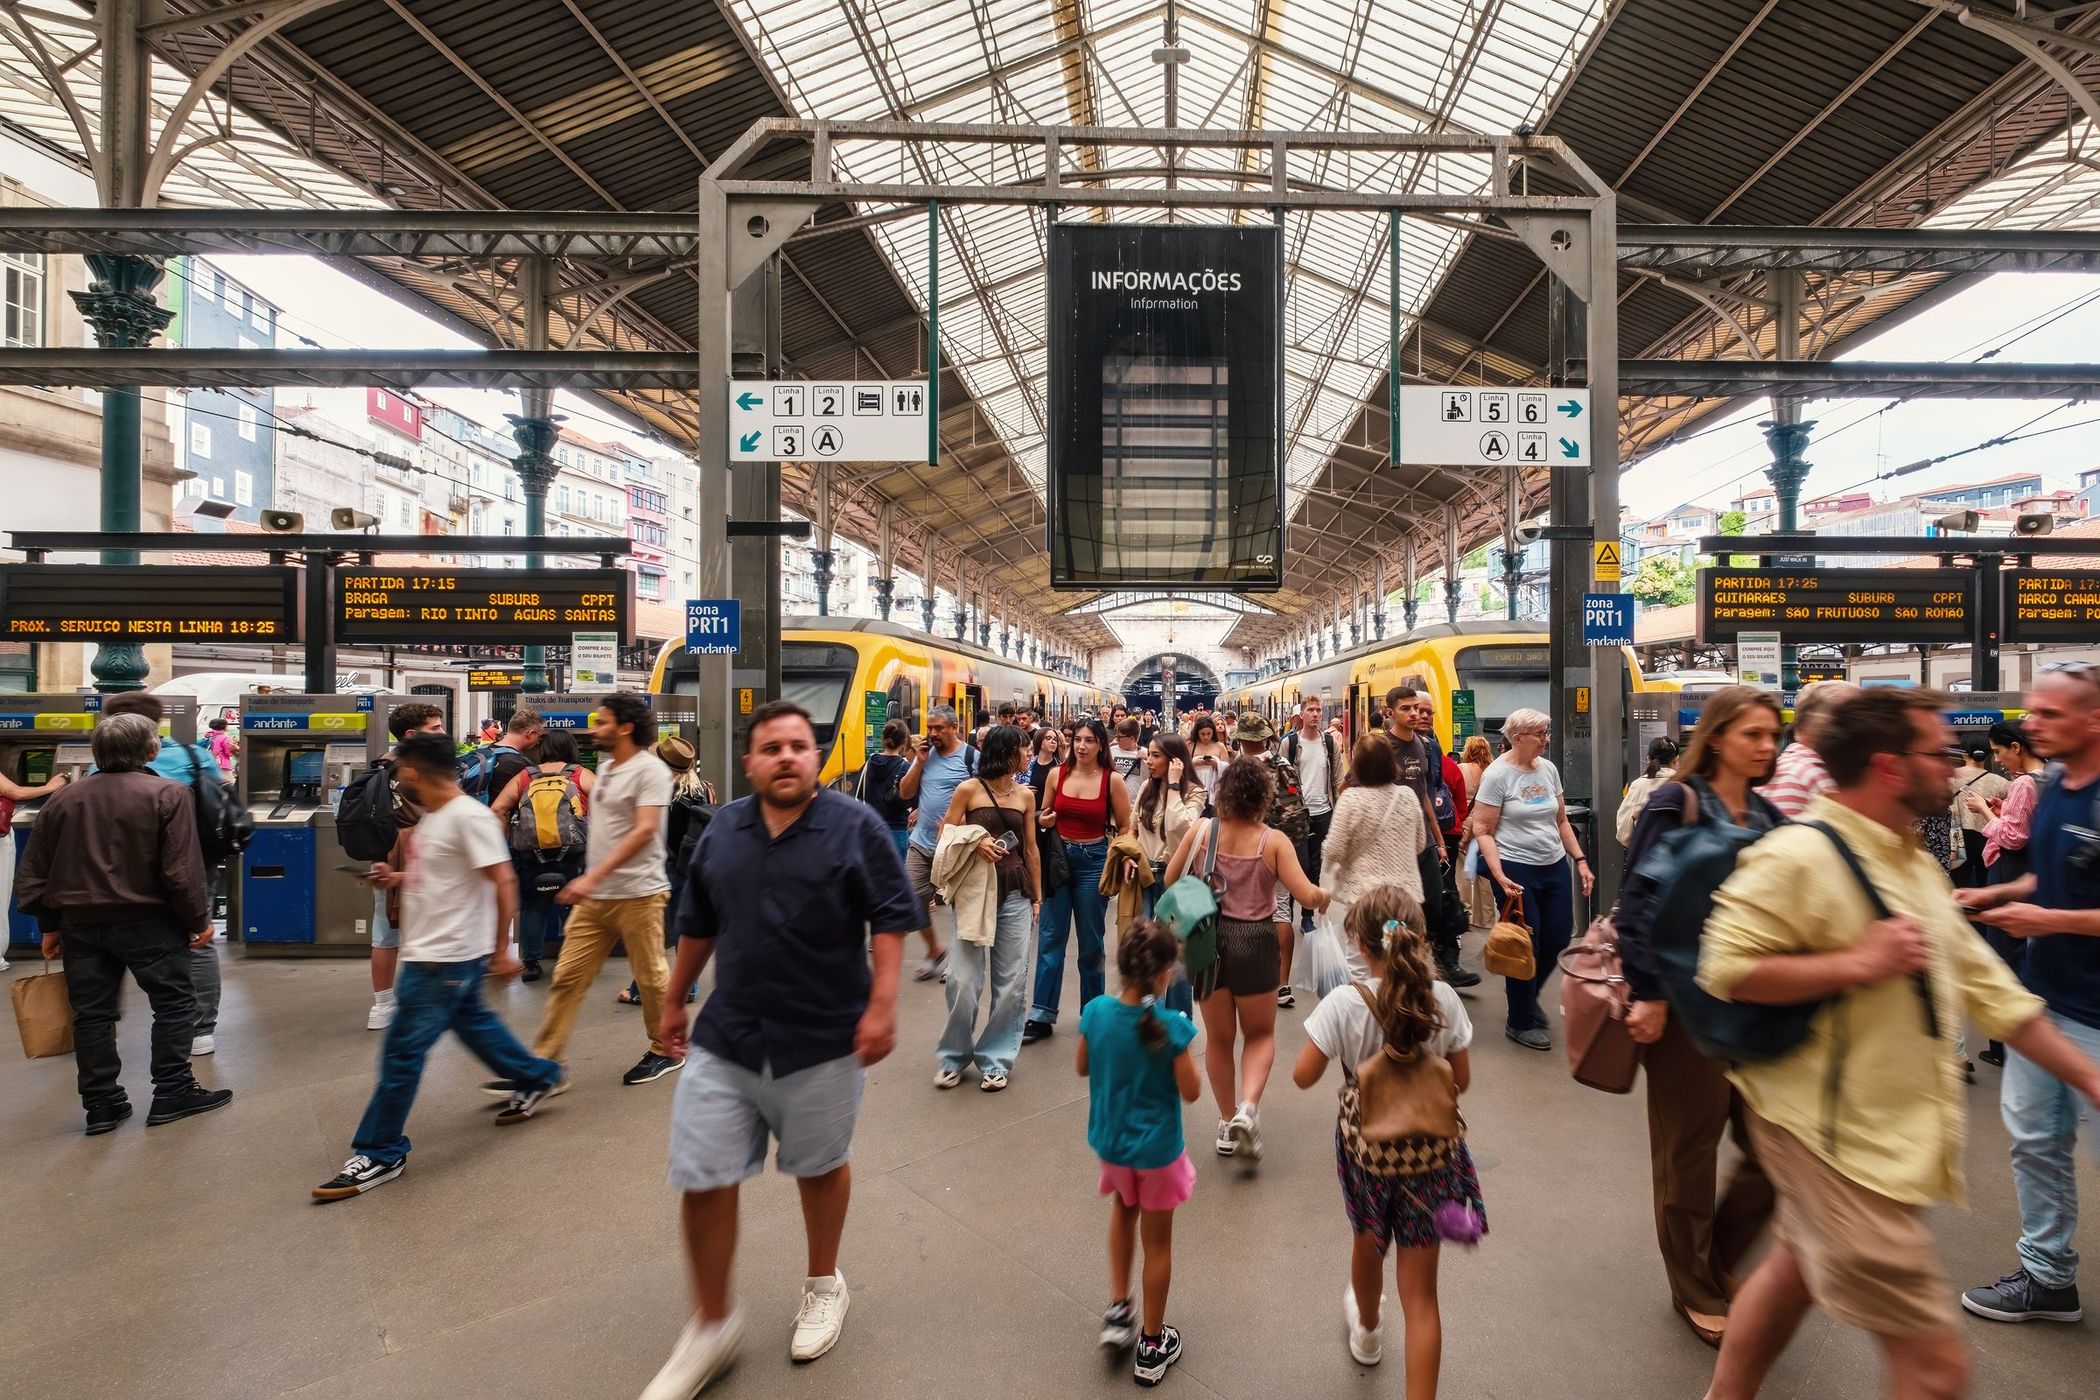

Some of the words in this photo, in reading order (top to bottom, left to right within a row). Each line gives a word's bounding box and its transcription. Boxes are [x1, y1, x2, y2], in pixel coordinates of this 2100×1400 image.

[1091, 268, 1242, 295] INFORMAÇÕES
[1130, 297, 1198, 310] Information
[784, 396, 793, 414] 1
[822, 396, 835, 414] 2
[1488, 403, 1500, 421] 5
[1525, 404, 1538, 421] 6
[783, 436, 796, 454] 3
[818, 432, 836, 450] A
[1486, 438, 1503, 456] A
[1524, 442, 1538, 459] 4
[345, 577, 404, 589] PARTIDA
[412, 578, 456, 590] 17:15
[1714, 577, 1770, 589] PARTIDA
[1778, 578, 1818, 589] 17:25
[2018, 578, 2072, 590] PARTIDA
[345, 592, 388, 604] BRAGA
[488, 593, 540, 606] SUBURB
[581, 594, 615, 606] CPPT
[1586, 600, 1613, 608] zona
[1848, 593, 1895, 604] SUBURB
[1933, 593, 1964, 604] CPPT
[2018, 593, 2057, 605] MARCO
[345, 607, 411, 620] Paragem:
[421, 608, 447, 619] RIO
[455, 608, 497, 620] TINTO
[565, 609, 616, 621] SANTAS
[689, 606, 718, 615] zona
[1714, 607, 1776, 619] Paragem:
[1817, 608, 1880, 618] FRUTUOSO
[2018, 608, 2077, 619] Paragem:
[689, 616, 728, 633] PRT1
[1586, 610, 1622, 626] PRT1
[128, 621, 172, 633] NESTA
[179, 621, 223, 633] LINHA
[230, 622, 274, 633] 18:25
[254, 718, 297, 728] andante
[544, 716, 575, 727] dante
[1954, 714, 1994, 724] andante
